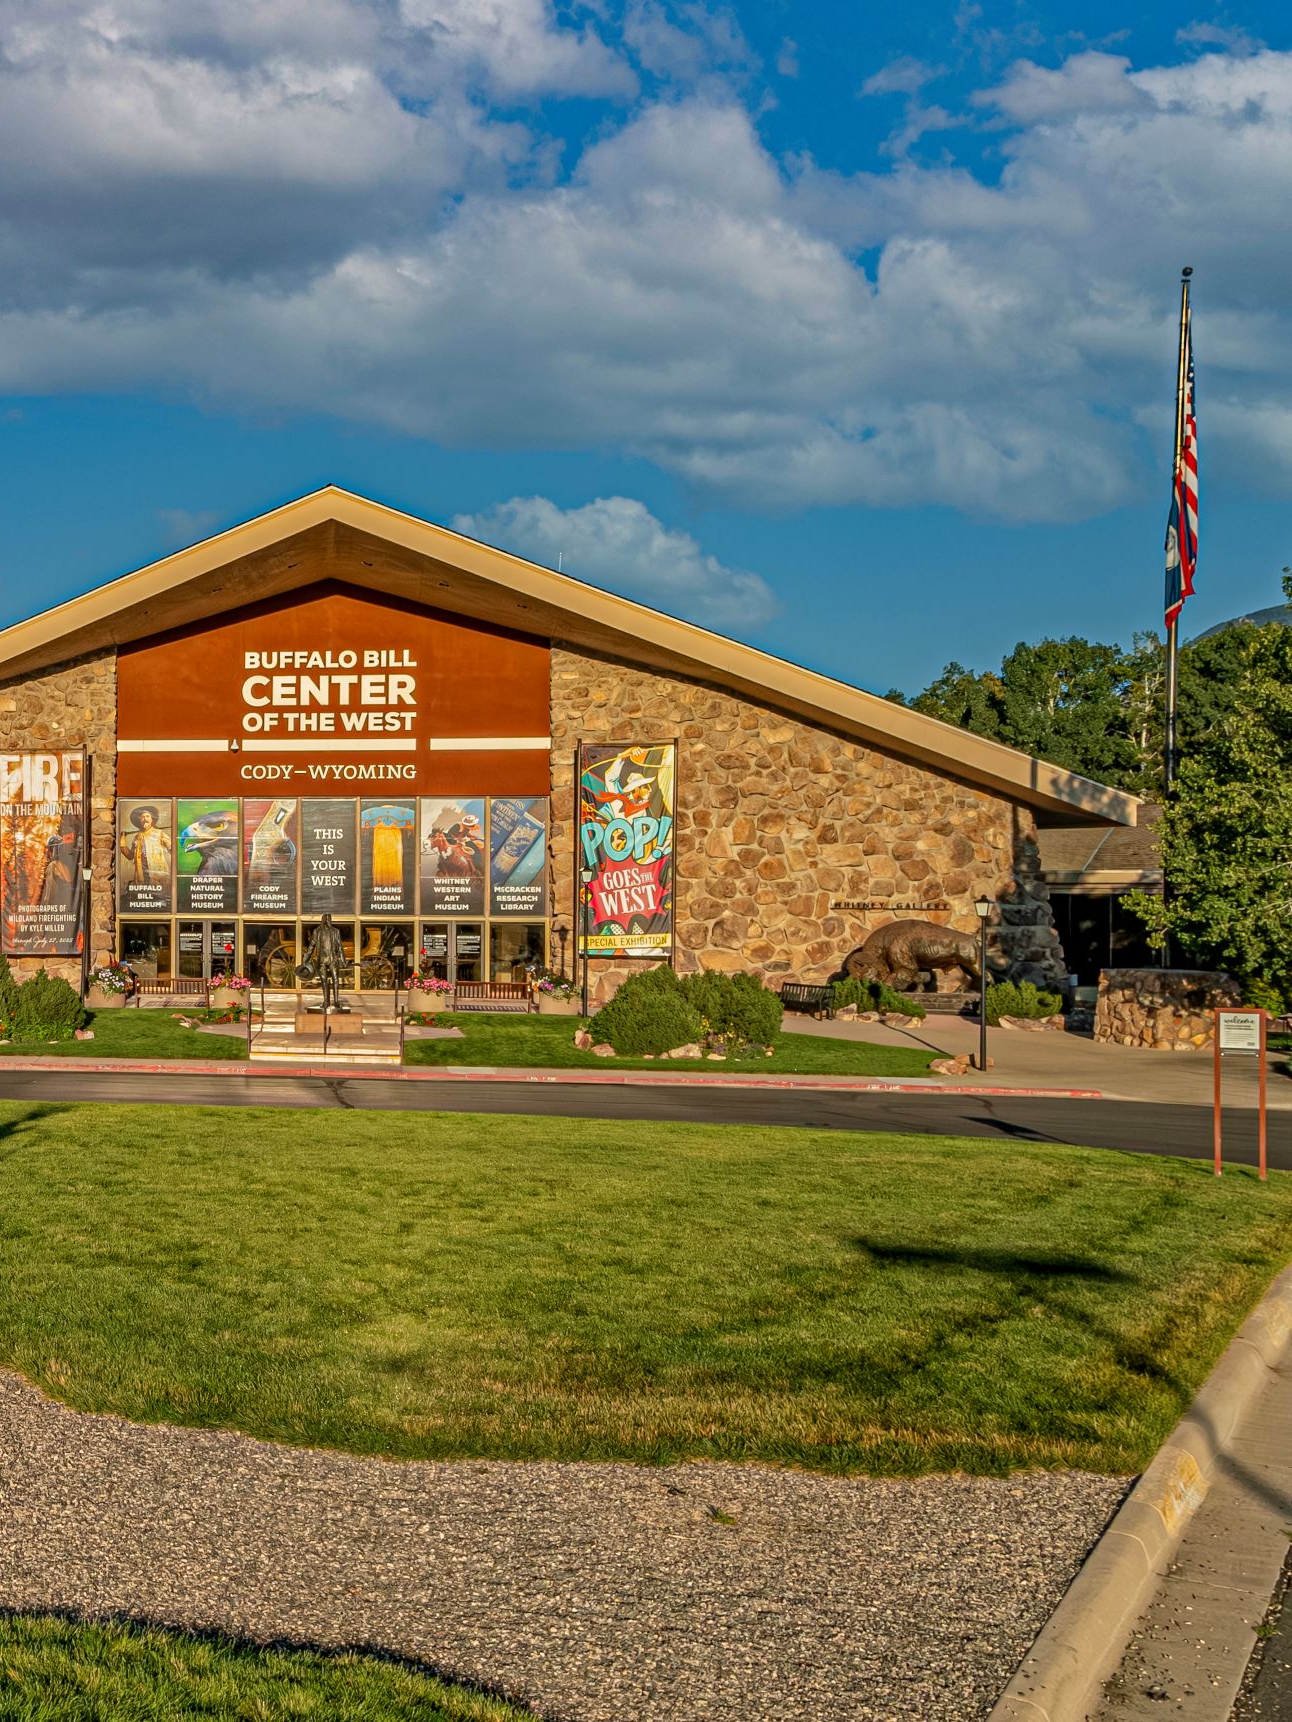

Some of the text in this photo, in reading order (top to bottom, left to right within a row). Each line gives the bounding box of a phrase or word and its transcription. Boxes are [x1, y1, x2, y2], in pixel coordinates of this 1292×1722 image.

[245, 649, 417, 669] BUFFALO BILL
[242, 674, 417, 707] CENTER
[242, 712, 416, 732] OF THE WEST
[0, 753, 82, 801] FIRE
[0, 802, 82, 815] ON THE MOUNTAIN
[314, 829, 343, 839] THIS
[581, 815, 672, 866] POP!
[323, 845, 334, 855] IS
[311, 860, 346, 870] YOUR
[311, 876, 346, 886] WEST
[603, 868, 653, 890] GOES THE
[599, 883, 656, 916] WEST
[33, 936, 48, 949] July
[621, 936, 667, 946] EXHIBITION
